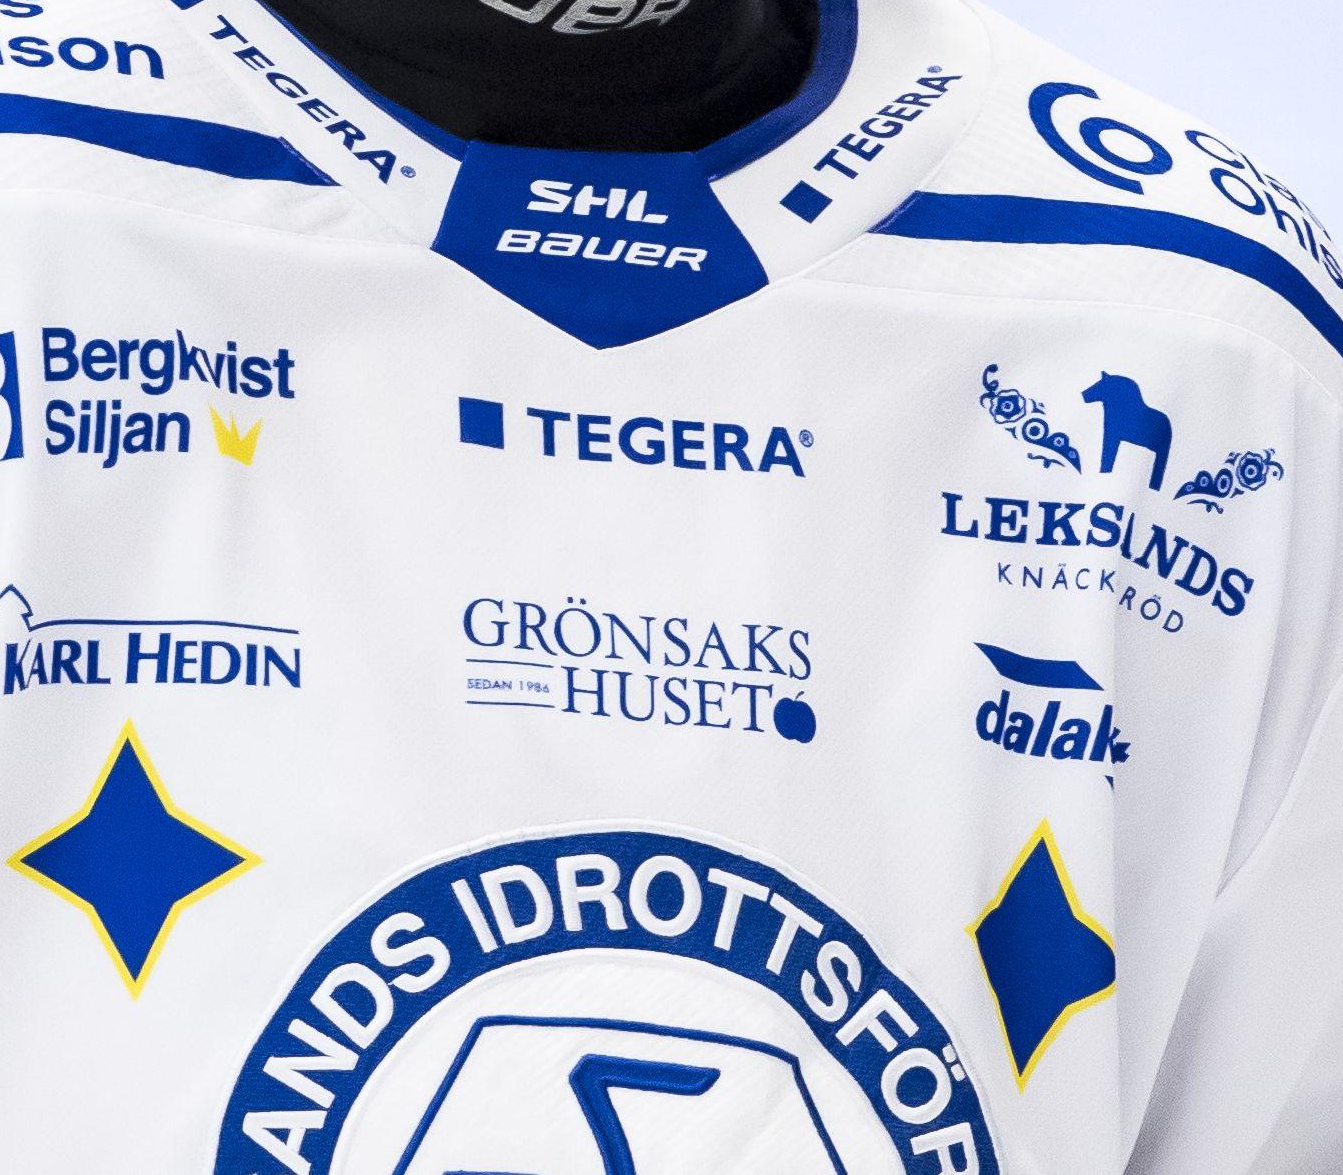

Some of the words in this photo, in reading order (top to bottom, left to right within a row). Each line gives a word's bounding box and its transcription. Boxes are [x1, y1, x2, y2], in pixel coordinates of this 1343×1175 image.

[526, 179, 669, 224] SHL
[1184, 129, 1333, 242] Cla
[495, 228, 709, 272] BAUER
[41, 326, 296, 400] Bergkvist
[44, 398, 191, 470] Siljan
[2, 636, 112, 696] KARL
[124, 631, 302, 689] HEDIN
[462, 596, 813, 681] GRÖNSAKS
[560, 665, 775, 733] HUSET
[240, 911, 452, 1175] ANDS
